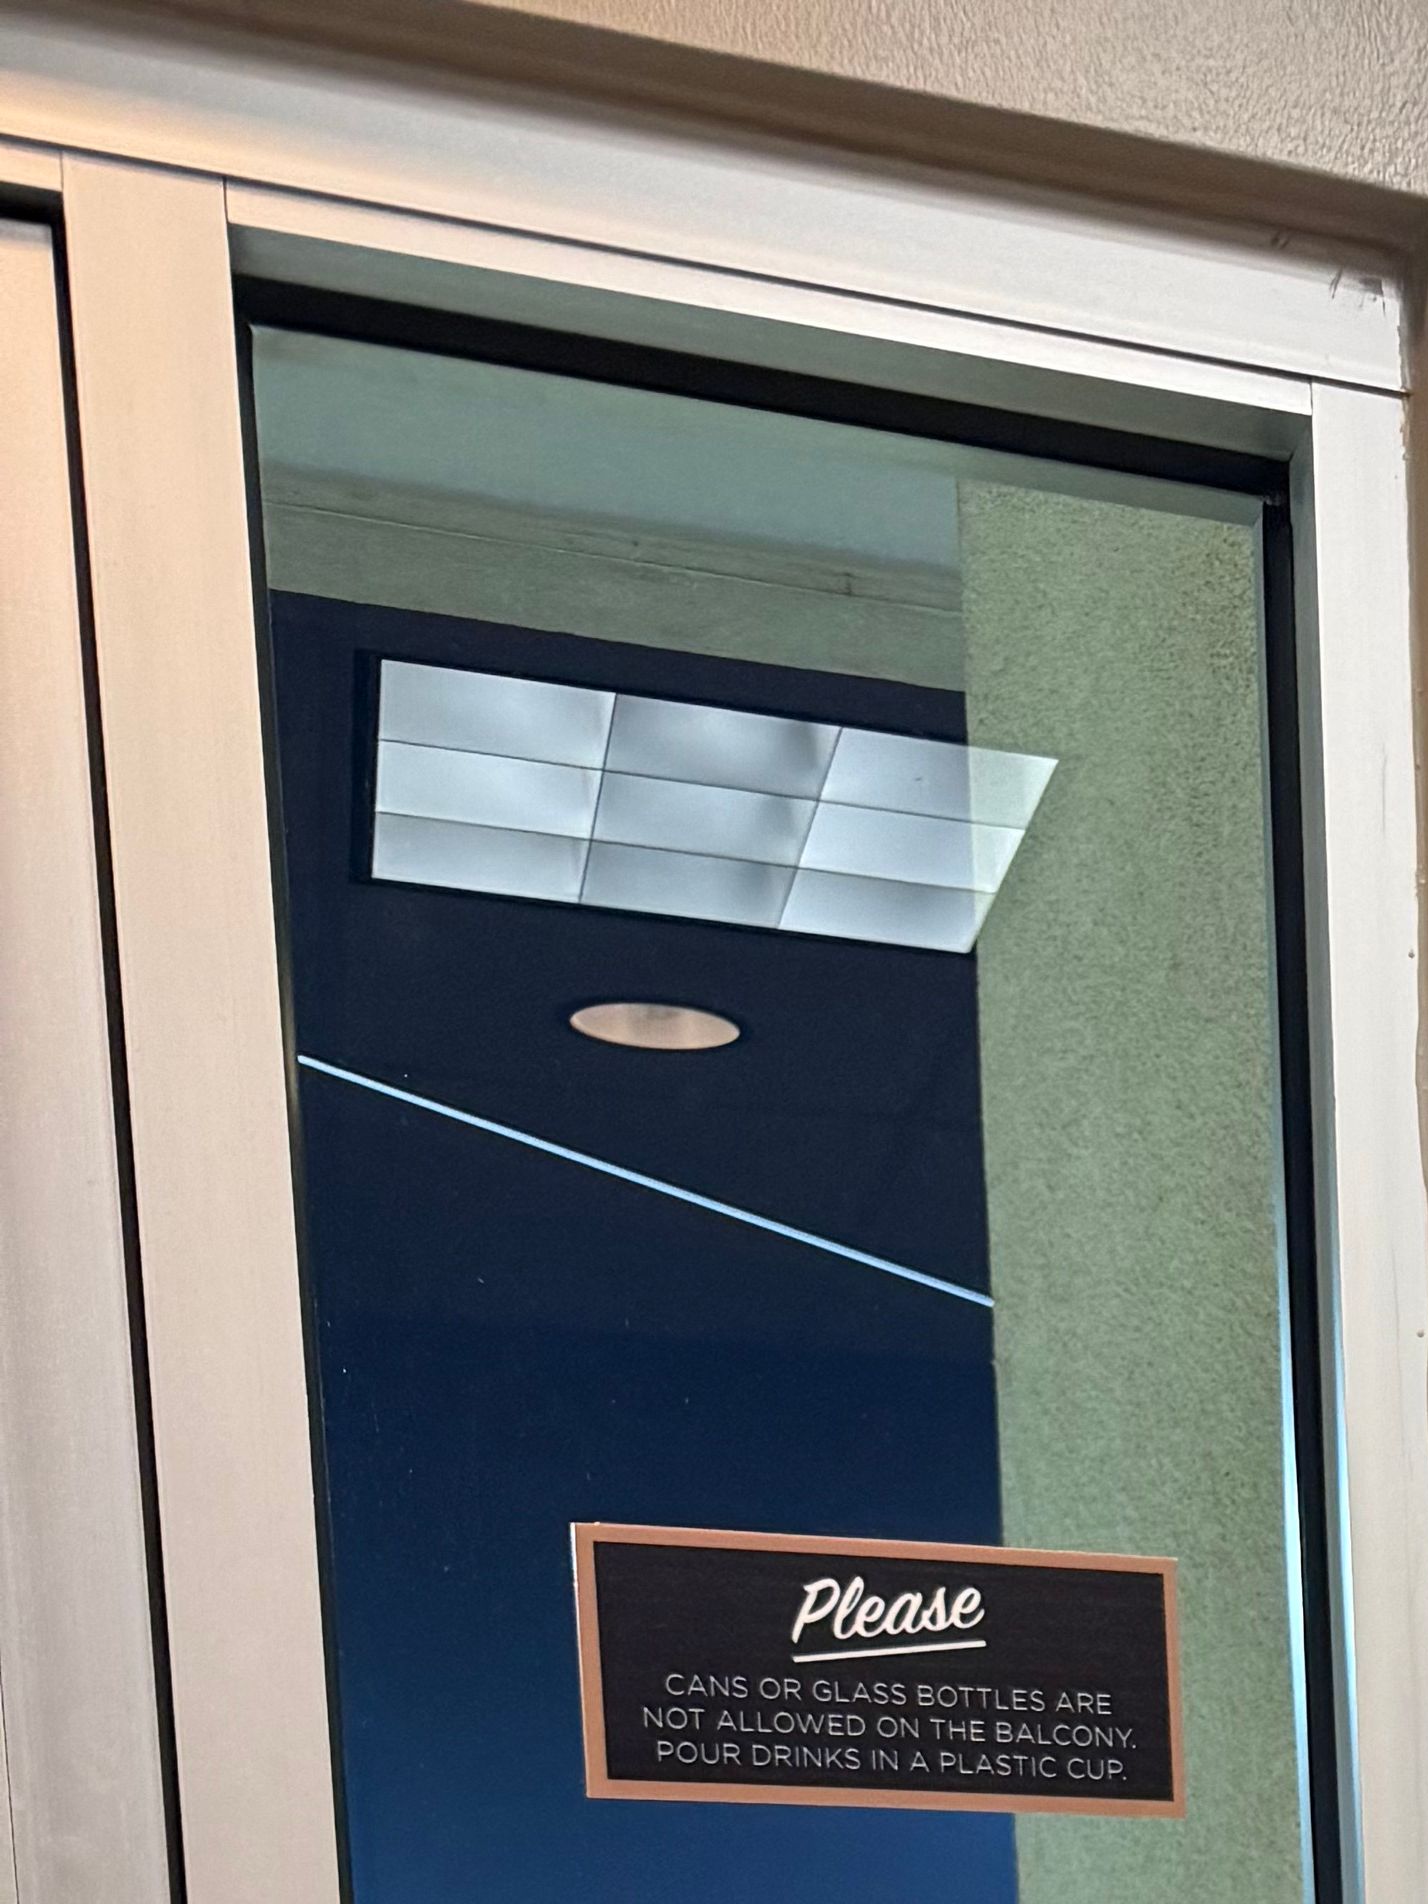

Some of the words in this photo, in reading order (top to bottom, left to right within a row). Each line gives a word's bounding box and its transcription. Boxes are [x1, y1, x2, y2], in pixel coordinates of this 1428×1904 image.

[790, 1575, 986, 1645] Please
[664, 1673, 749, 1699] CANS
[759, 1677, 803, 1701] OR
[812, 1680, 907, 1706] GLASS
[916, 1684, 1046, 1712] BOTTLES
[1055, 1691, 1113, 1715] ARE
[642, 1706, 706, 1731] NOT
[716, 1709, 867, 1737] ALLOWED
[876, 1716, 920, 1740] ON
[929, 1718, 987, 1743] THE
[995, 1721, 1137, 1750] BALCONY.
[656, 1740, 742, 1766] POUR
[751, 1744, 861, 1771] DRINKS
[871, 1749, 899, 1772] IN
[909, 1751, 930, 1773] A
[940, 1752, 1057, 1779] PLASTIC
[1066, 1757, 1128, 1782] CUP.
